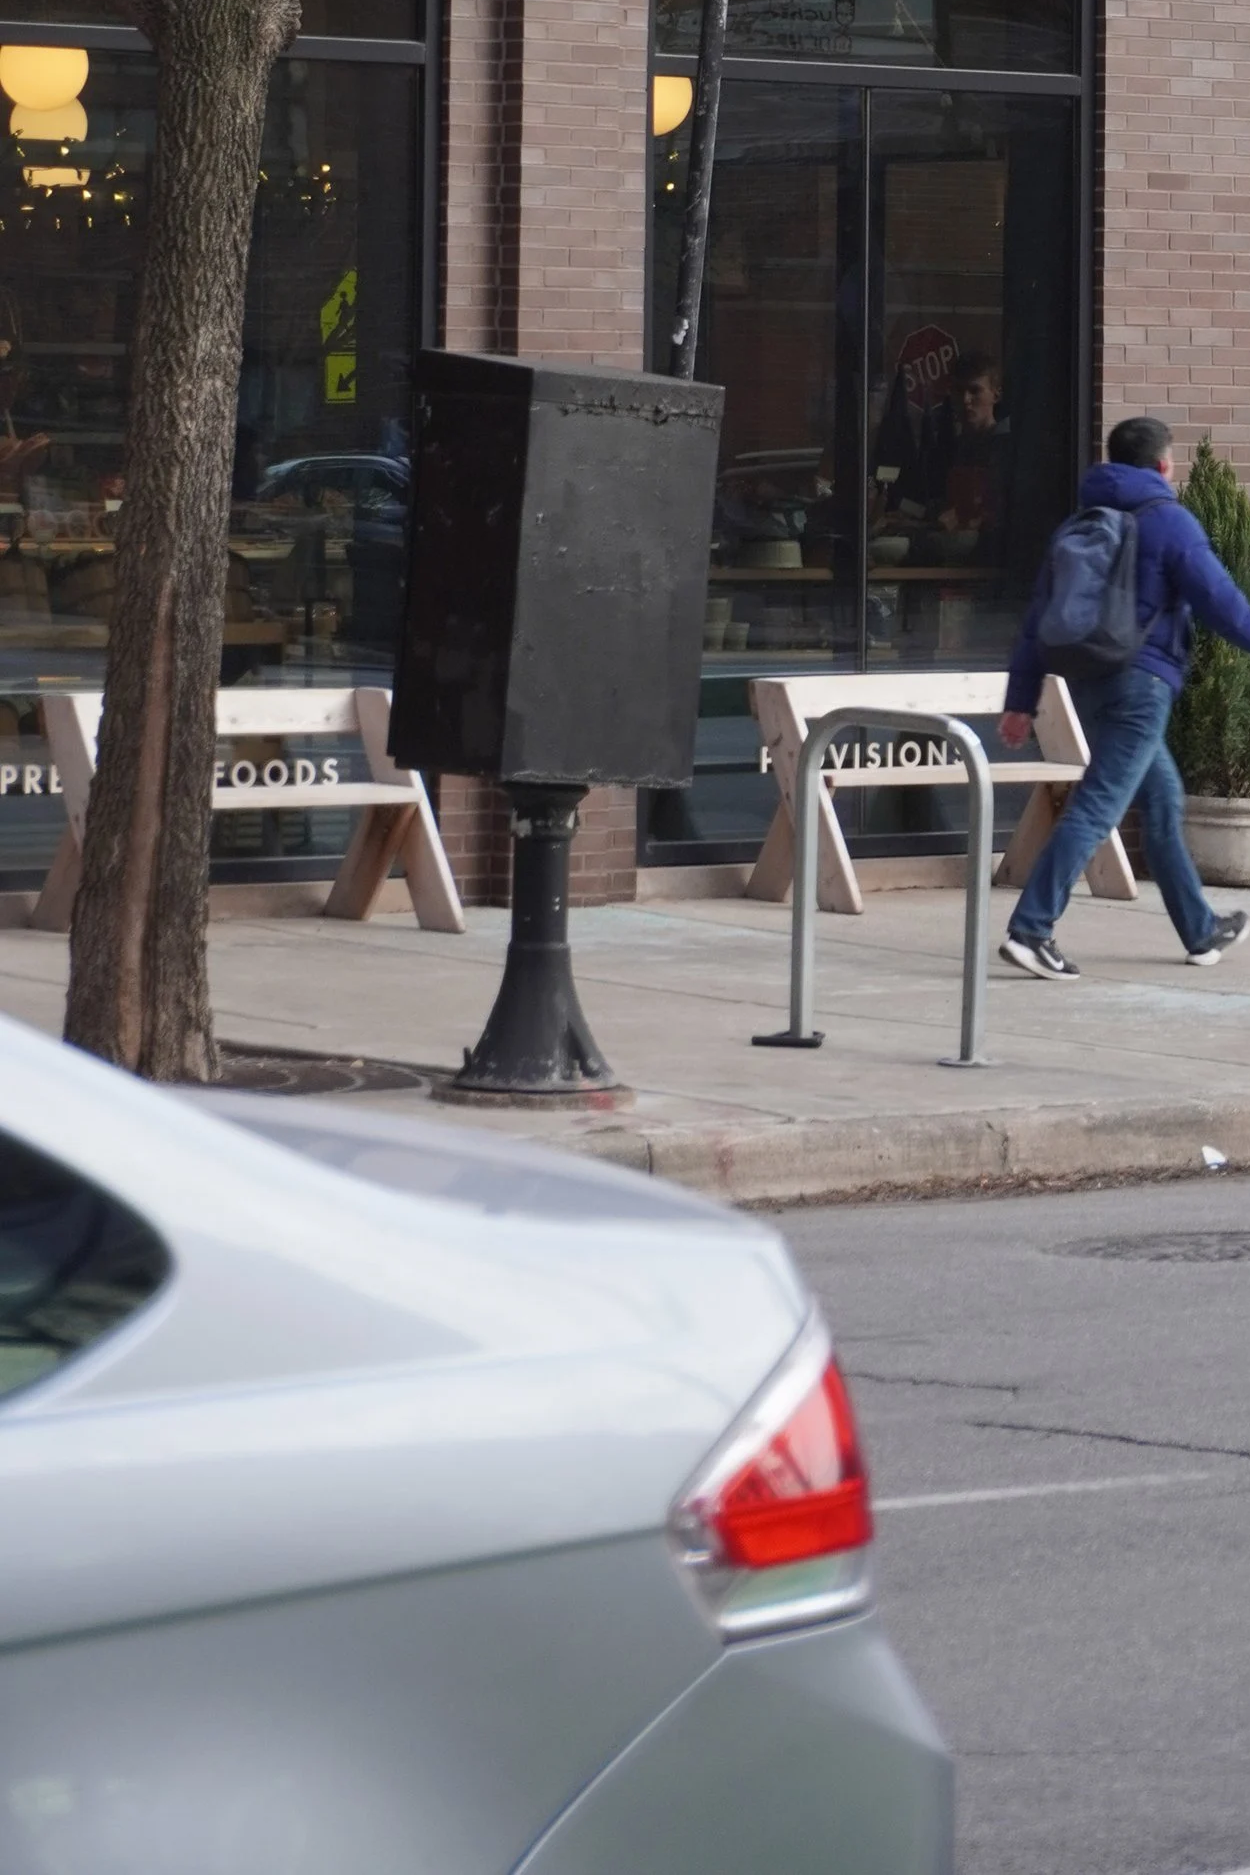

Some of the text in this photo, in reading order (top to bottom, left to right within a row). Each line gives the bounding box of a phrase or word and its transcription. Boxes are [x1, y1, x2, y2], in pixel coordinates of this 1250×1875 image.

[903, 345, 954, 392] STOP
[213, 757, 340, 788] FOODS
[760, 740, 965, 774] PVISION
